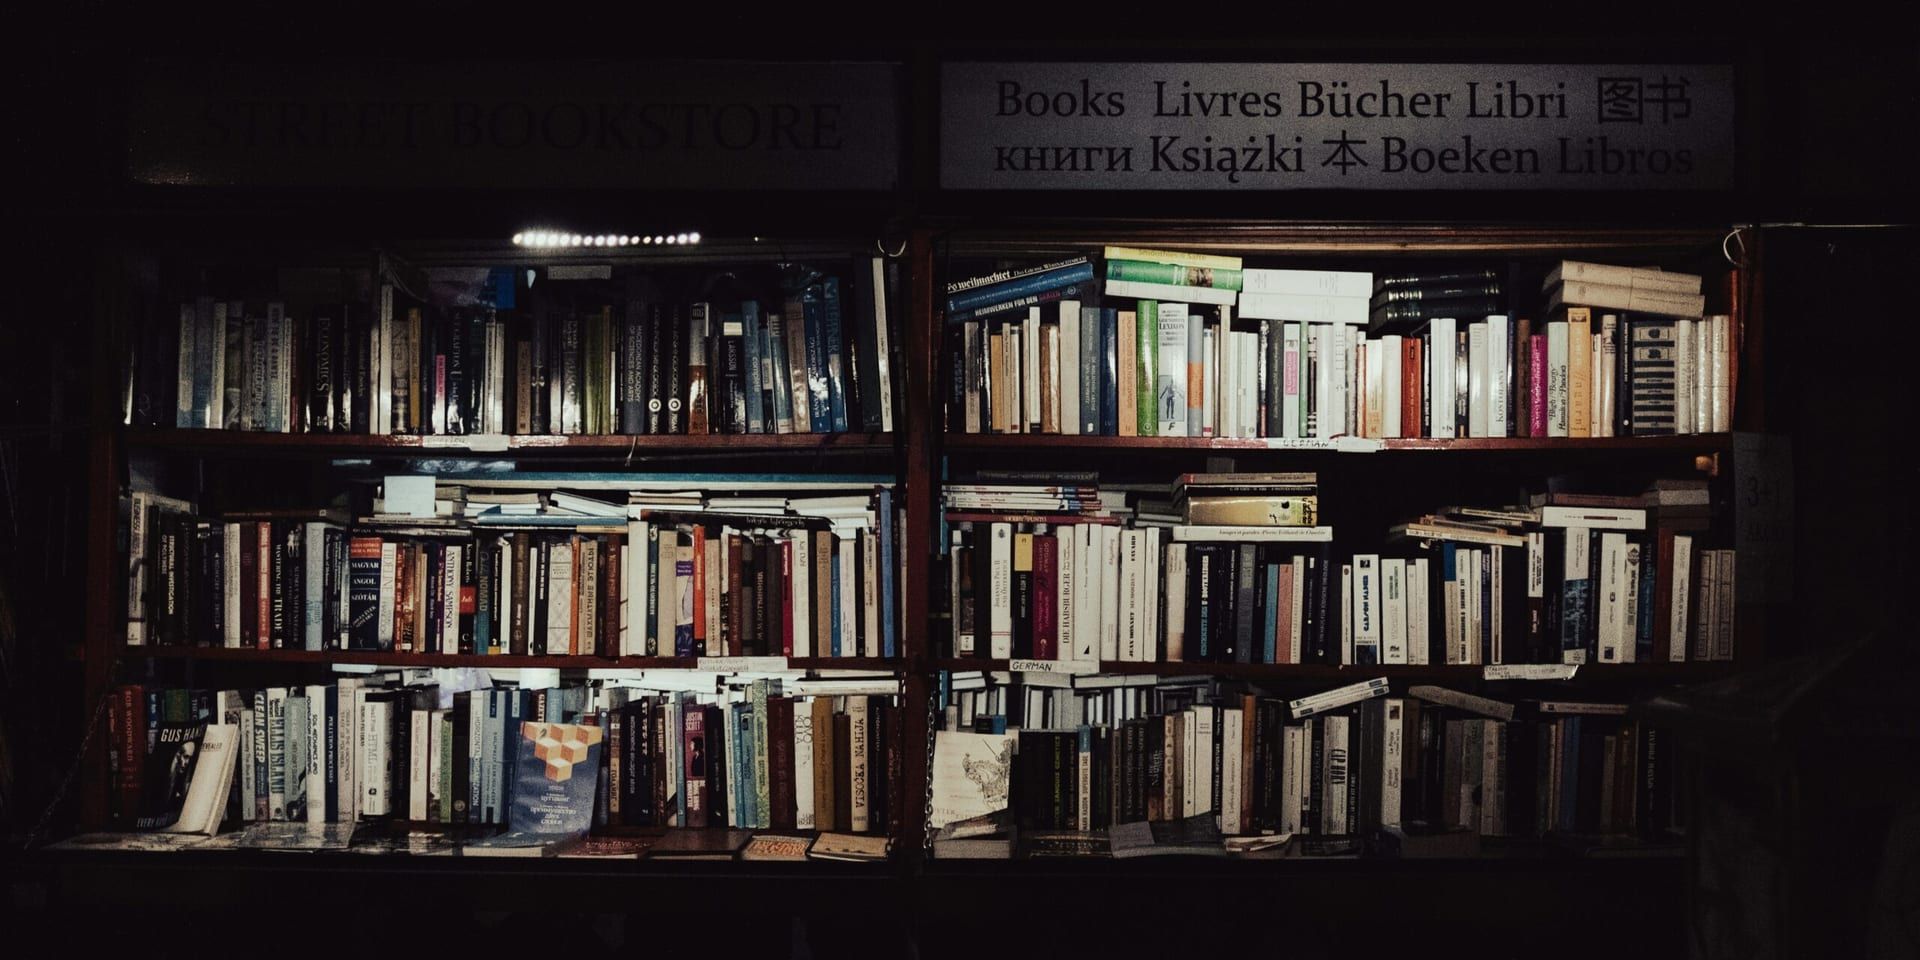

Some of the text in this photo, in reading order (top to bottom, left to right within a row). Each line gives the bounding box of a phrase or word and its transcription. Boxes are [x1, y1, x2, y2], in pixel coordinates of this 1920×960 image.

[997, 76, 1691, 125] Books Livres Bücher Libri 图书
[202, 101, 844, 151] STREET BOOKSTORE
[993, 128, 1693, 182] книги Książki 本 Boeken Libros
[316, 317, 330, 391] ECONOMICS
[728, 340, 736, 371] LARSSON
[752, 357, 760, 392] complete
[352, 561, 379, 569] MAGYAR
[352, 592, 377, 601] SZÓTÁR
[445, 551, 455, 628] ANTHONY SAMPSON
[480, 576, 488, 611] NOMAD
[274, 597, 282, 632] TRADE
[1012, 662, 1052, 671] GERMAN
[160, 728, 181, 743] GUS
[255, 694, 265, 763] CLEAN SWEEP
[270, 719, 285, 794] ELLIS ISLAND
[369, 734, 377, 762] HTML
[854, 718, 864, 808] VISOČKA NAHIJA
